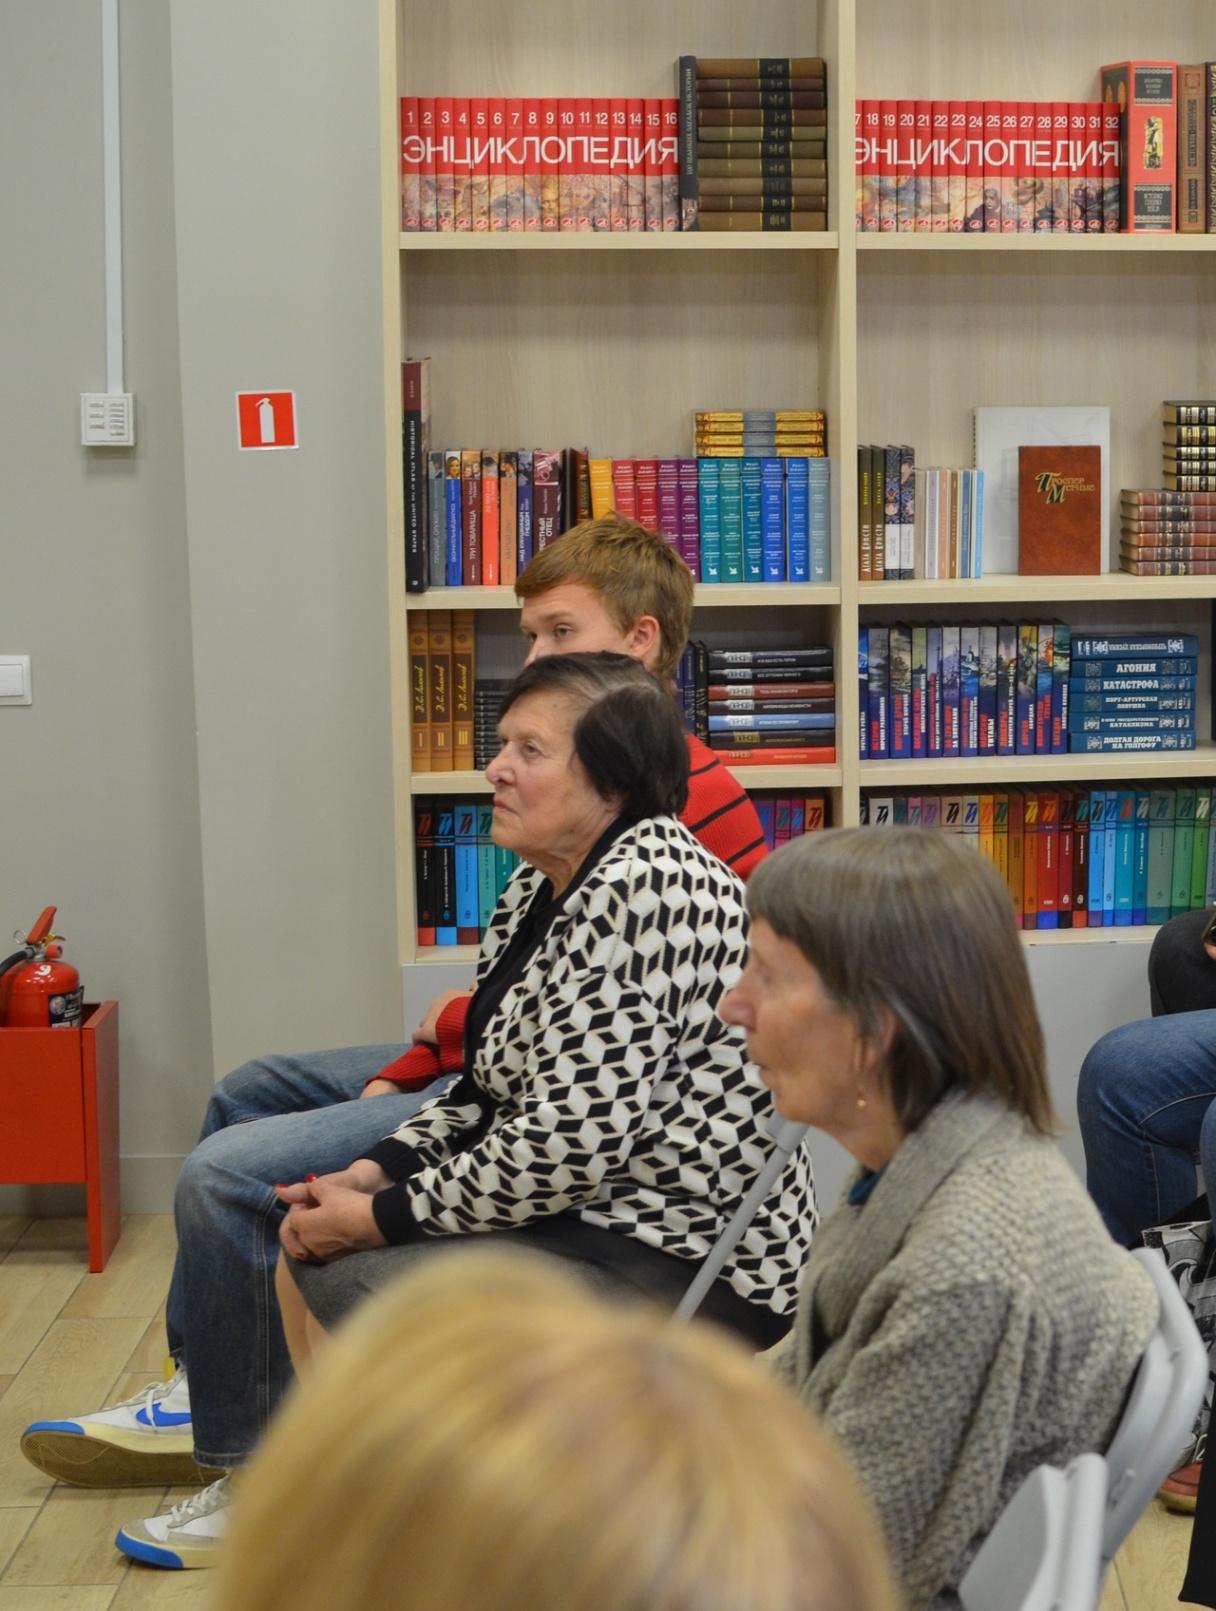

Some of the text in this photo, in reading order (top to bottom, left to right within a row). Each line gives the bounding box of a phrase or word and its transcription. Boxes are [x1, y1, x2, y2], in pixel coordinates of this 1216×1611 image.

[408, 111, 677, 125] 1 2 3 4 5 6 7 8 9 10 11 12 13 14 15 16
[867, 113, 879, 125] 18
[883, 114, 895, 126] 19
[901, 113, 913, 126] 20
[918, 114, 930, 126] 21
[934, 115, 948, 127] 22
[952, 113, 965, 125] 23
[969, 116, 982, 128] 24
[987, 115, 1000, 127] 25
[1003, 115, 1016, 127] 26
[1020, 115, 1033, 128] 27
[1038, 115, 1051, 128] 28
[1054, 115, 1068, 128] 29
[1072, 116, 1085, 128] 30
[1090, 116, 1100, 128] 31
[1105, 116, 1118, 129] 32
[403, 136, 679, 169] ЭНЦИКЛОПЕДИЯ
[856, 138, 1119, 171] ЭНЦИКЛОПЕДИЯ
[469, 510, 477, 546] ТОВАРИЩА
[546, 517, 554, 536] ОТЕЦ
[1116, 664, 1157, 673] АГОНИЯ
[1103, 680, 1159, 690] КАТАСТРОФА
[952, 740, 958, 748] ЗА
